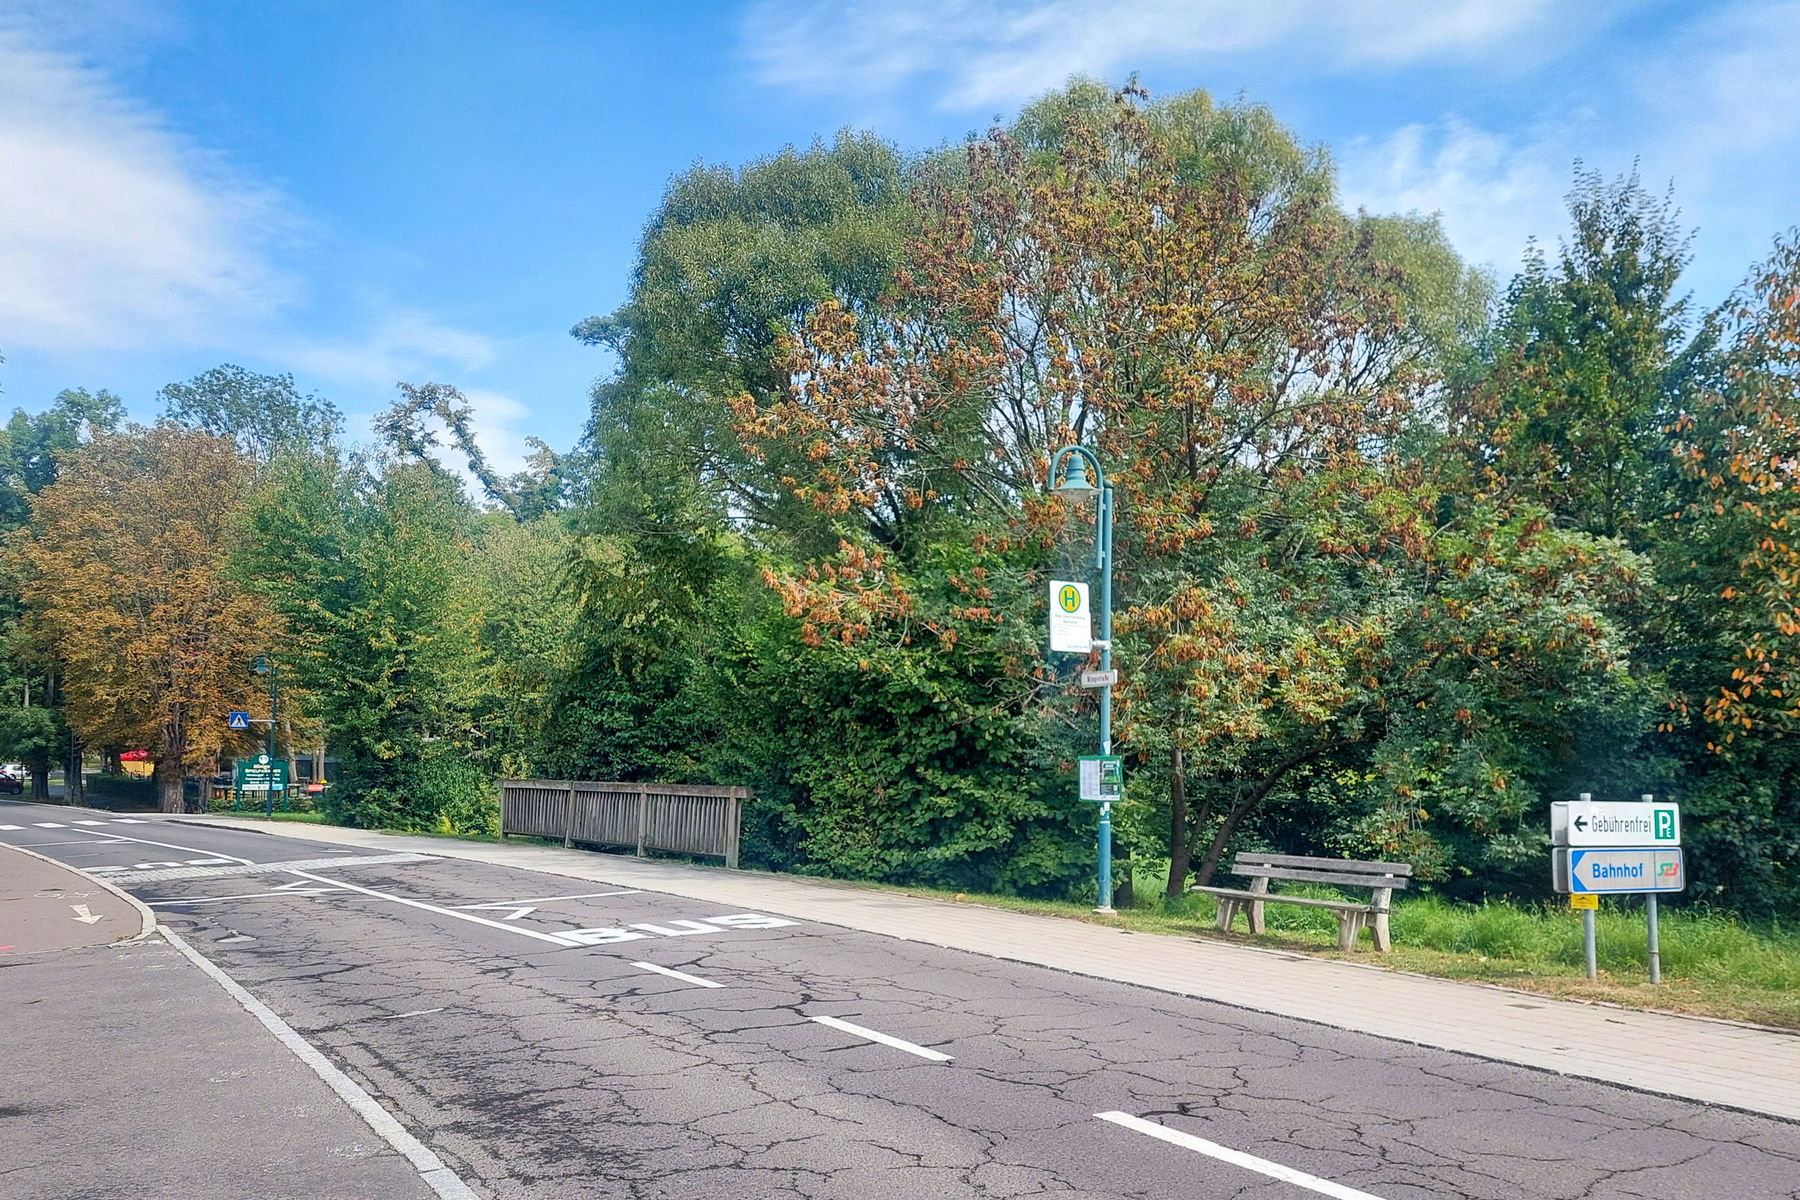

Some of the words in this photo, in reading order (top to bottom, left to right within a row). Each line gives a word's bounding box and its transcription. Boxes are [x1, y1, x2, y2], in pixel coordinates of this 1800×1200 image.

[1064, 590, 1076, 607] H
[1591, 815, 1652, 833] Gebührenfrei
[1592, 863, 1643, 878] Bahnhof
[550, 913, 802, 945] BUS
